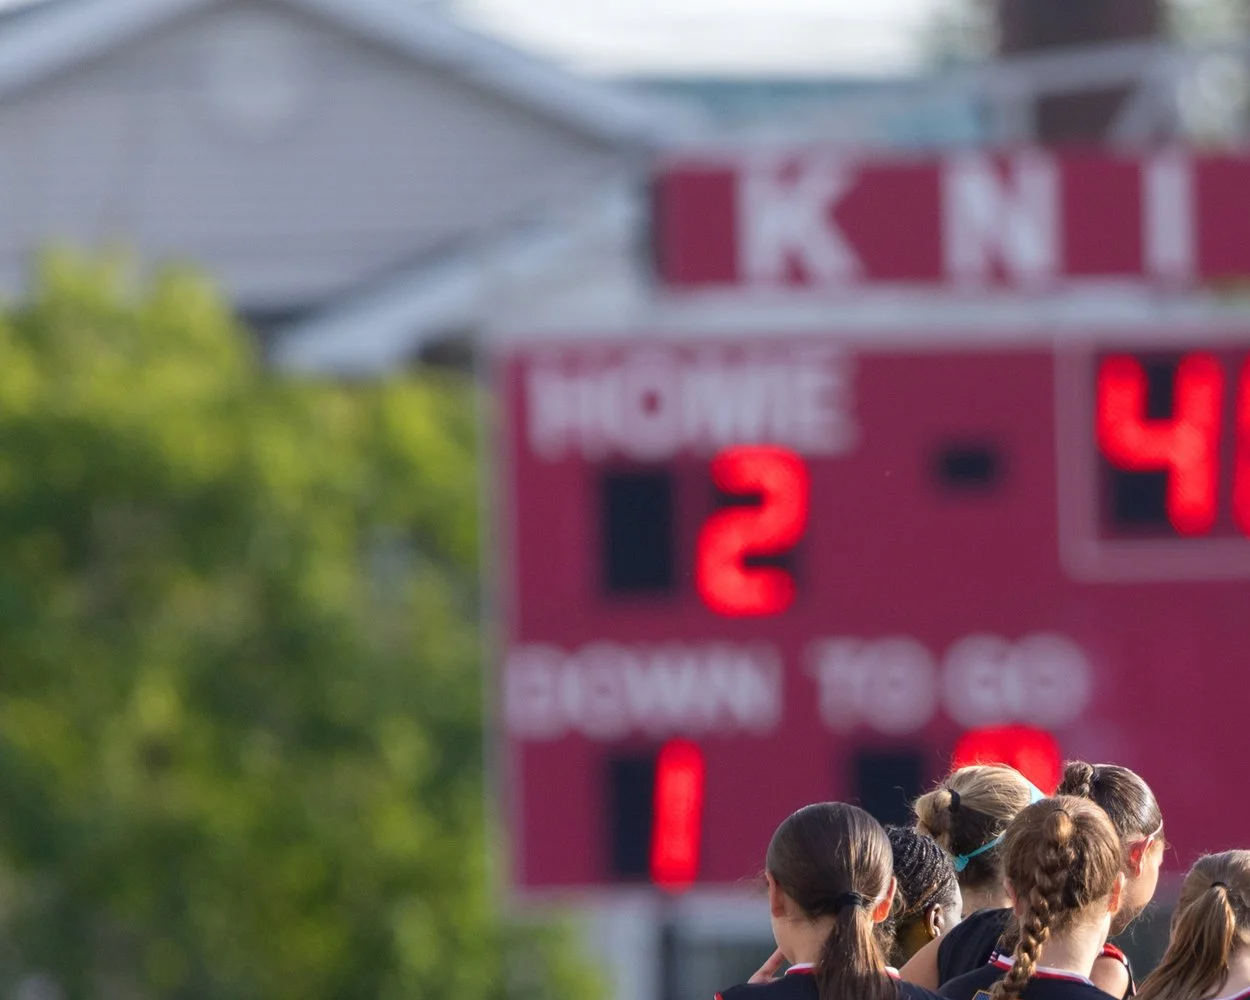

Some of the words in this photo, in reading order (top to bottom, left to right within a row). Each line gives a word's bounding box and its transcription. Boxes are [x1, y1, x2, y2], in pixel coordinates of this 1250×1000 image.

[524, 350, 857, 455] HOME
[696, 446, 809, 617] 2
[506, 641, 783, 741] DOWN
[810, 636, 934, 733] TO
[941, 632, 1091, 729] GO
[650, 738, 705, 892] 1
